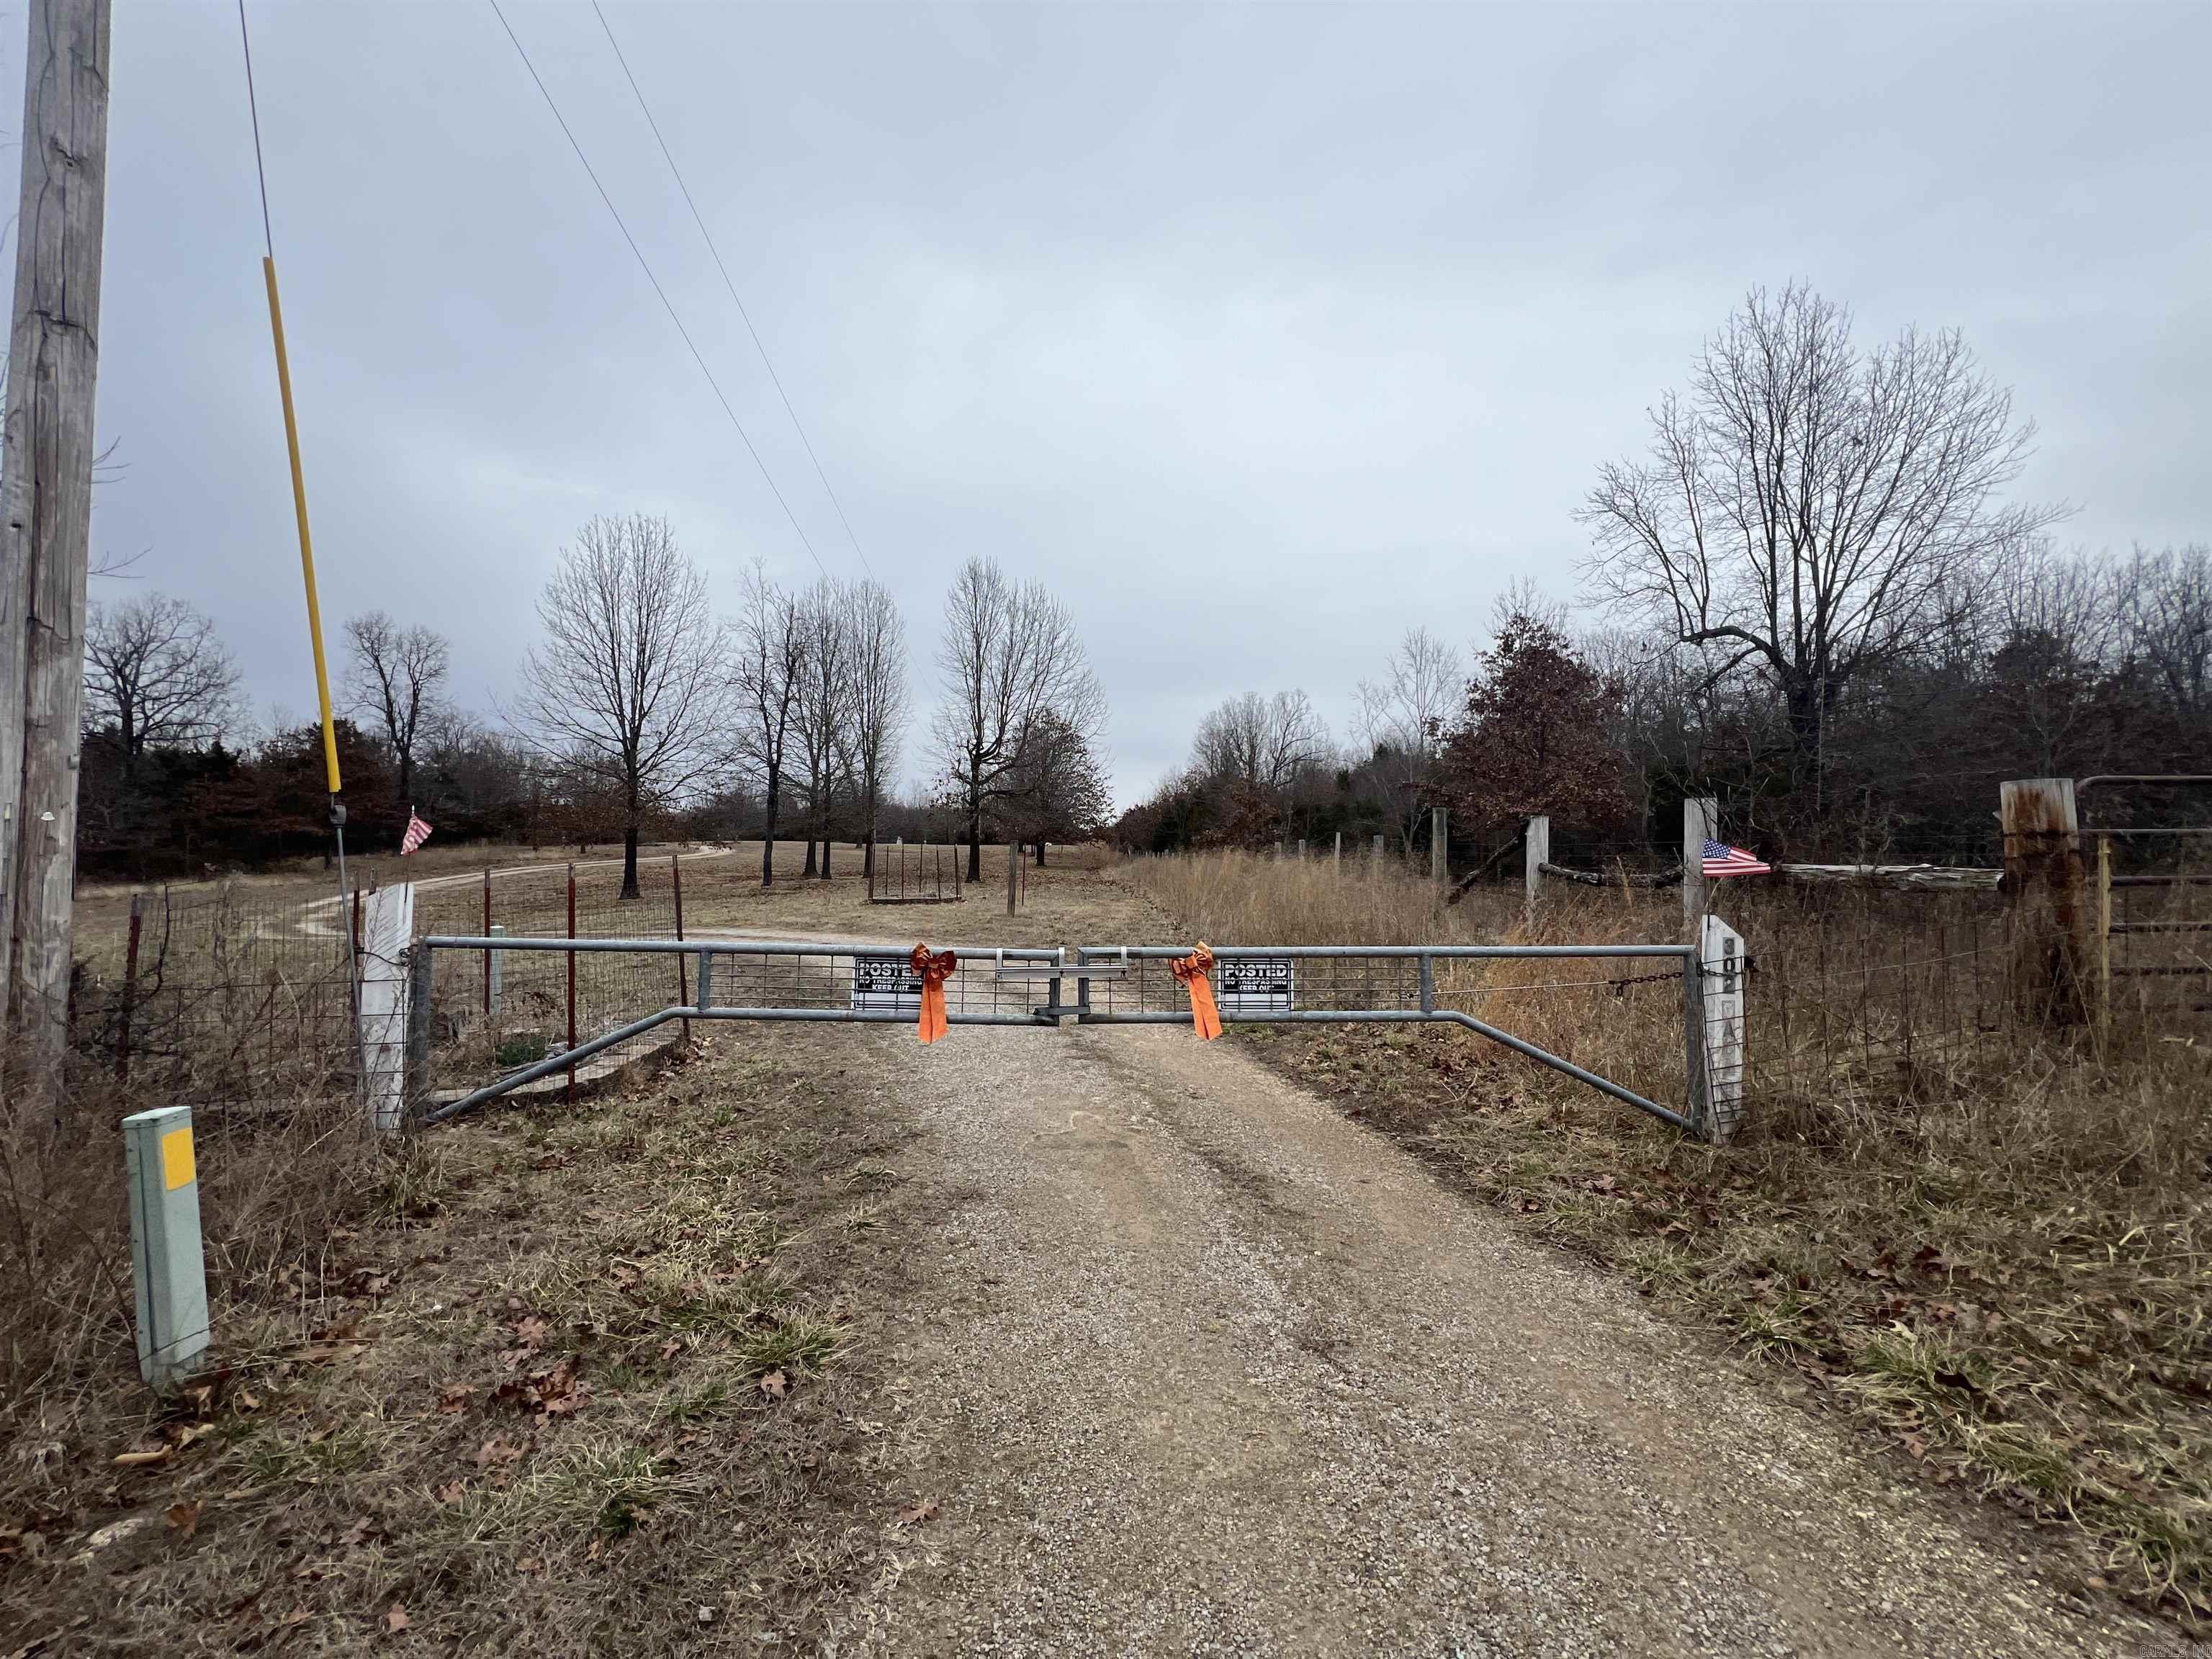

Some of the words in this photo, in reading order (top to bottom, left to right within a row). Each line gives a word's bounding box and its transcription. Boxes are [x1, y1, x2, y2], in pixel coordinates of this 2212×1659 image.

[859, 963, 917, 976] POSTE
[1225, 964, 1287, 977] POSTED
[872, 976, 922, 985] TRESPASSING
[1225, 976, 1236, 985] NO
[1239, 976, 1287, 985] TRESPASSING
